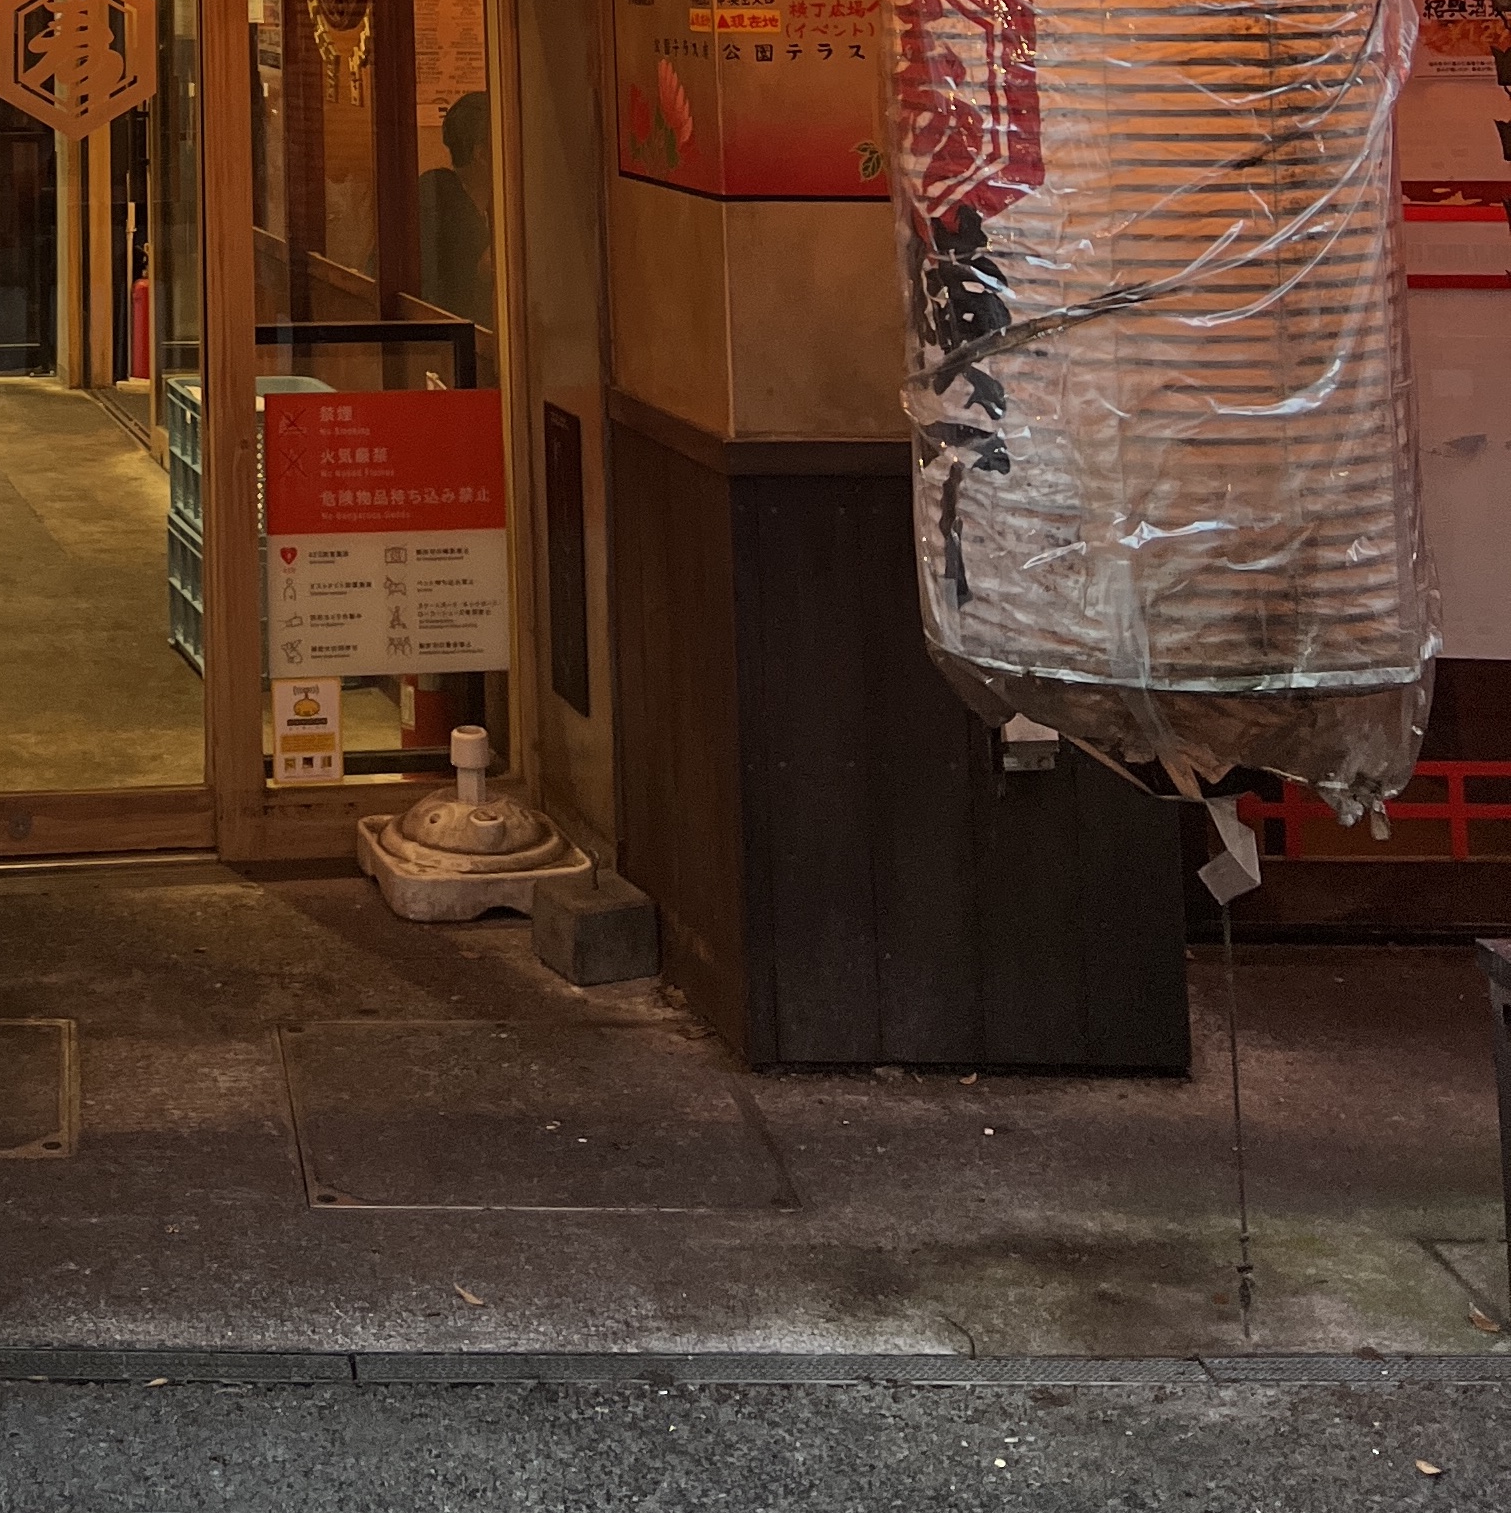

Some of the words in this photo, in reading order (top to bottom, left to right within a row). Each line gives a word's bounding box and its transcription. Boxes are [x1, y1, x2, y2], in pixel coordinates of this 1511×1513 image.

[790, 0, 866, 18] 横丁広場
[320, 406, 352, 422] 禁煙
[320, 448, 388, 464] 火気厳禁
